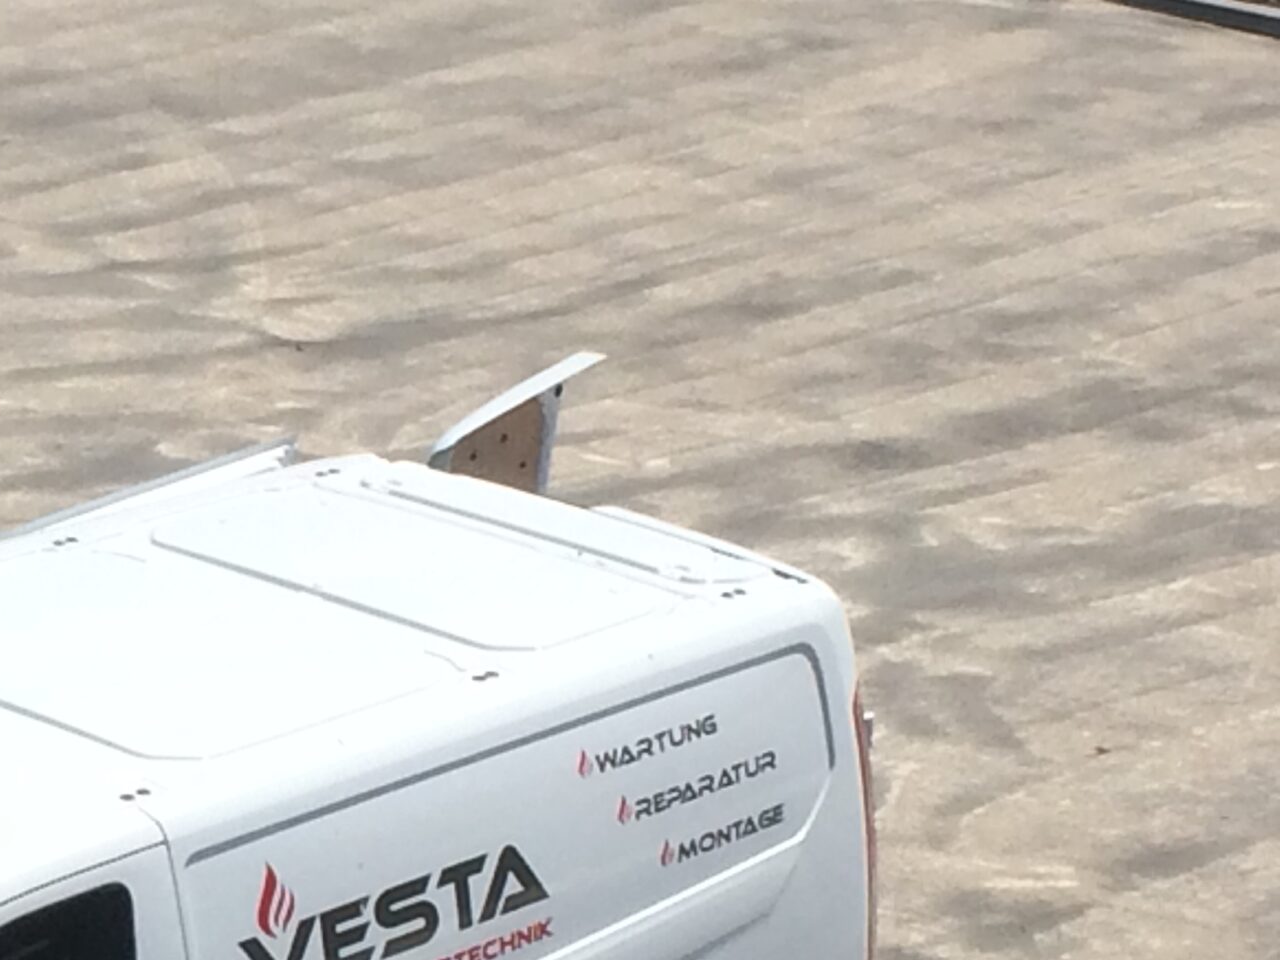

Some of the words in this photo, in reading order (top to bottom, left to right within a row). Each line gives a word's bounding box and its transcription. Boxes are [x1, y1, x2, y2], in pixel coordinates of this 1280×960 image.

[594, 714, 718, 774] WARTUNG
[633, 750, 777, 821] REPARATUR
[675, 803, 785, 864] MONTAGE
